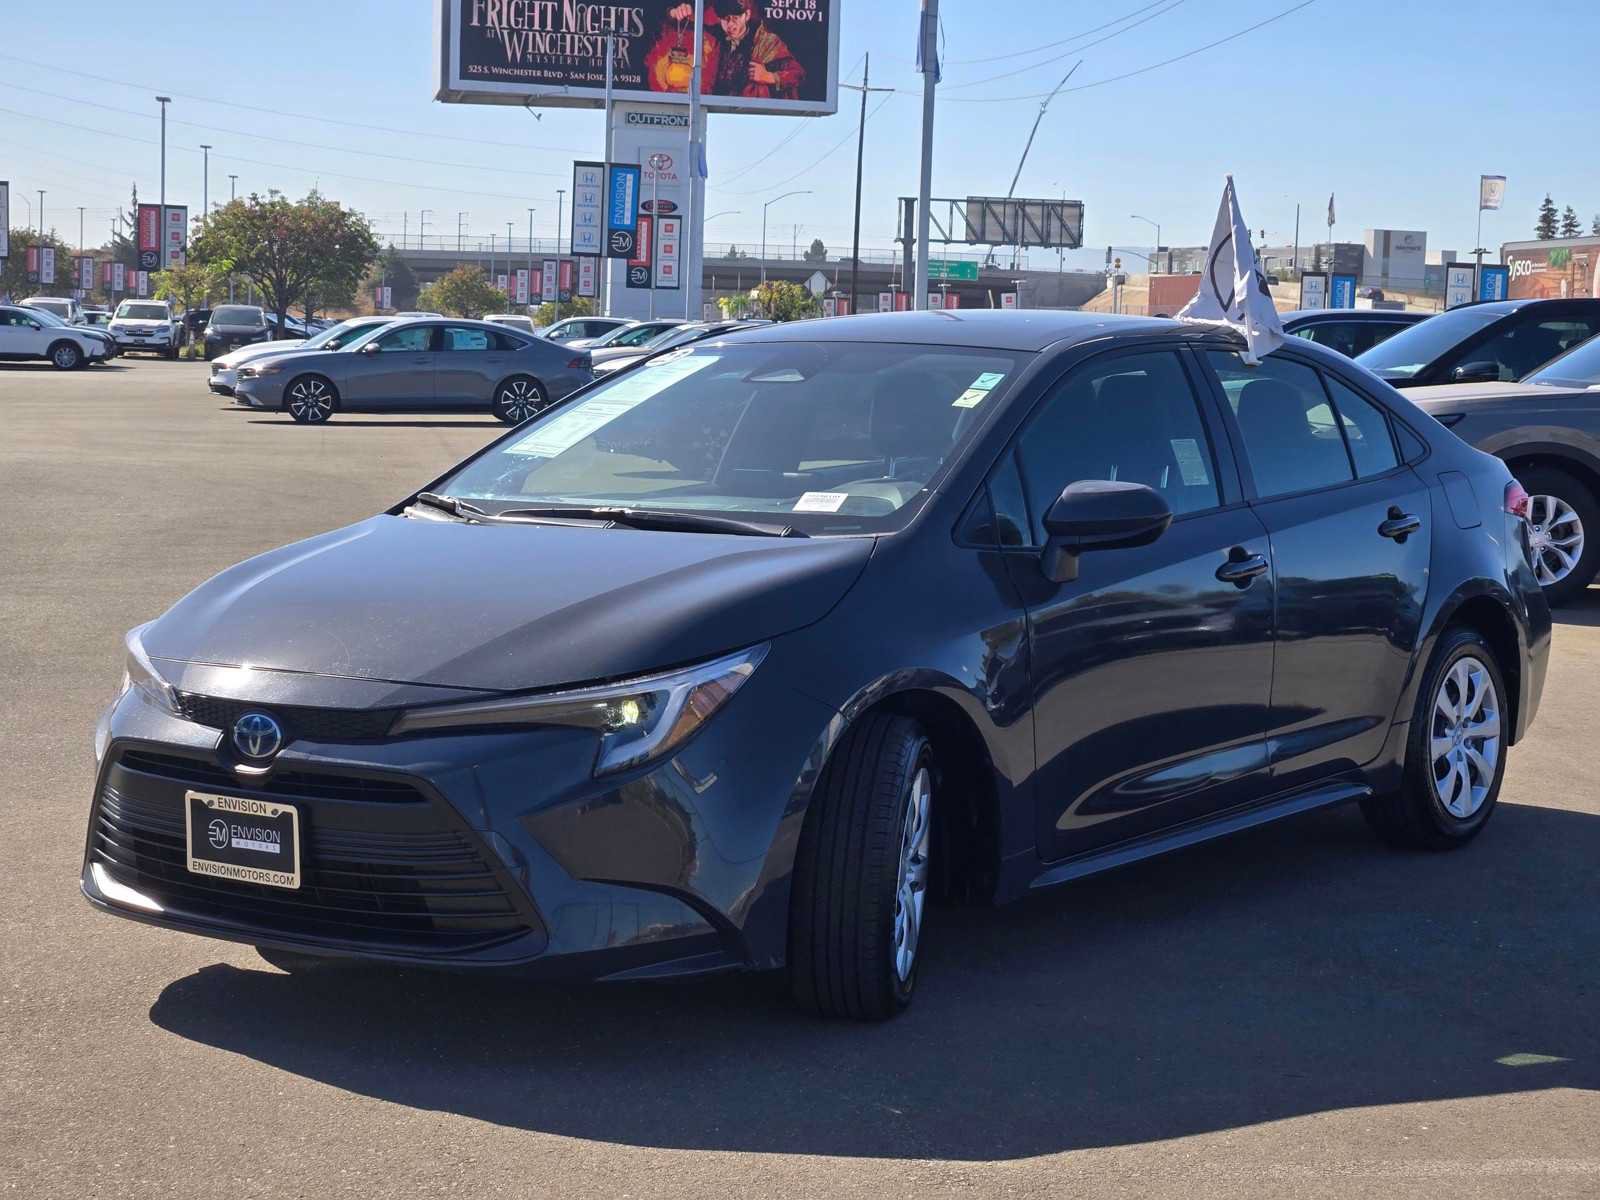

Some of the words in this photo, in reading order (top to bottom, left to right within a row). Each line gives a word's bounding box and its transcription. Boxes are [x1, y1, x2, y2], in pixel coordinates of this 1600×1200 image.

[771, 0, 799, 8] SEPT
[805, 0, 817, 9] 18
[470, 0, 558, 41] FRIGHT
[560, 0, 644, 38] NIGHTS
[764, 8, 783, 19] TO
[786, 9, 816, 21] NOV
[818, 12, 823, 22] 1
[502, 29, 630, 67] WINCHESTER
[491, 66, 542, 77] WINCHESTER
[543, 70, 564, 79] BLVD
[569, 72, 585, 80] SAN
[644, 171, 678, 180] TOOTA
[614, 172, 626, 225] ENVISION
[217, 797, 267, 814] ENVISION
[231, 824, 280, 843] ENVISION
[192, 860, 295, 886] ENVISIONMOTORS.COM
